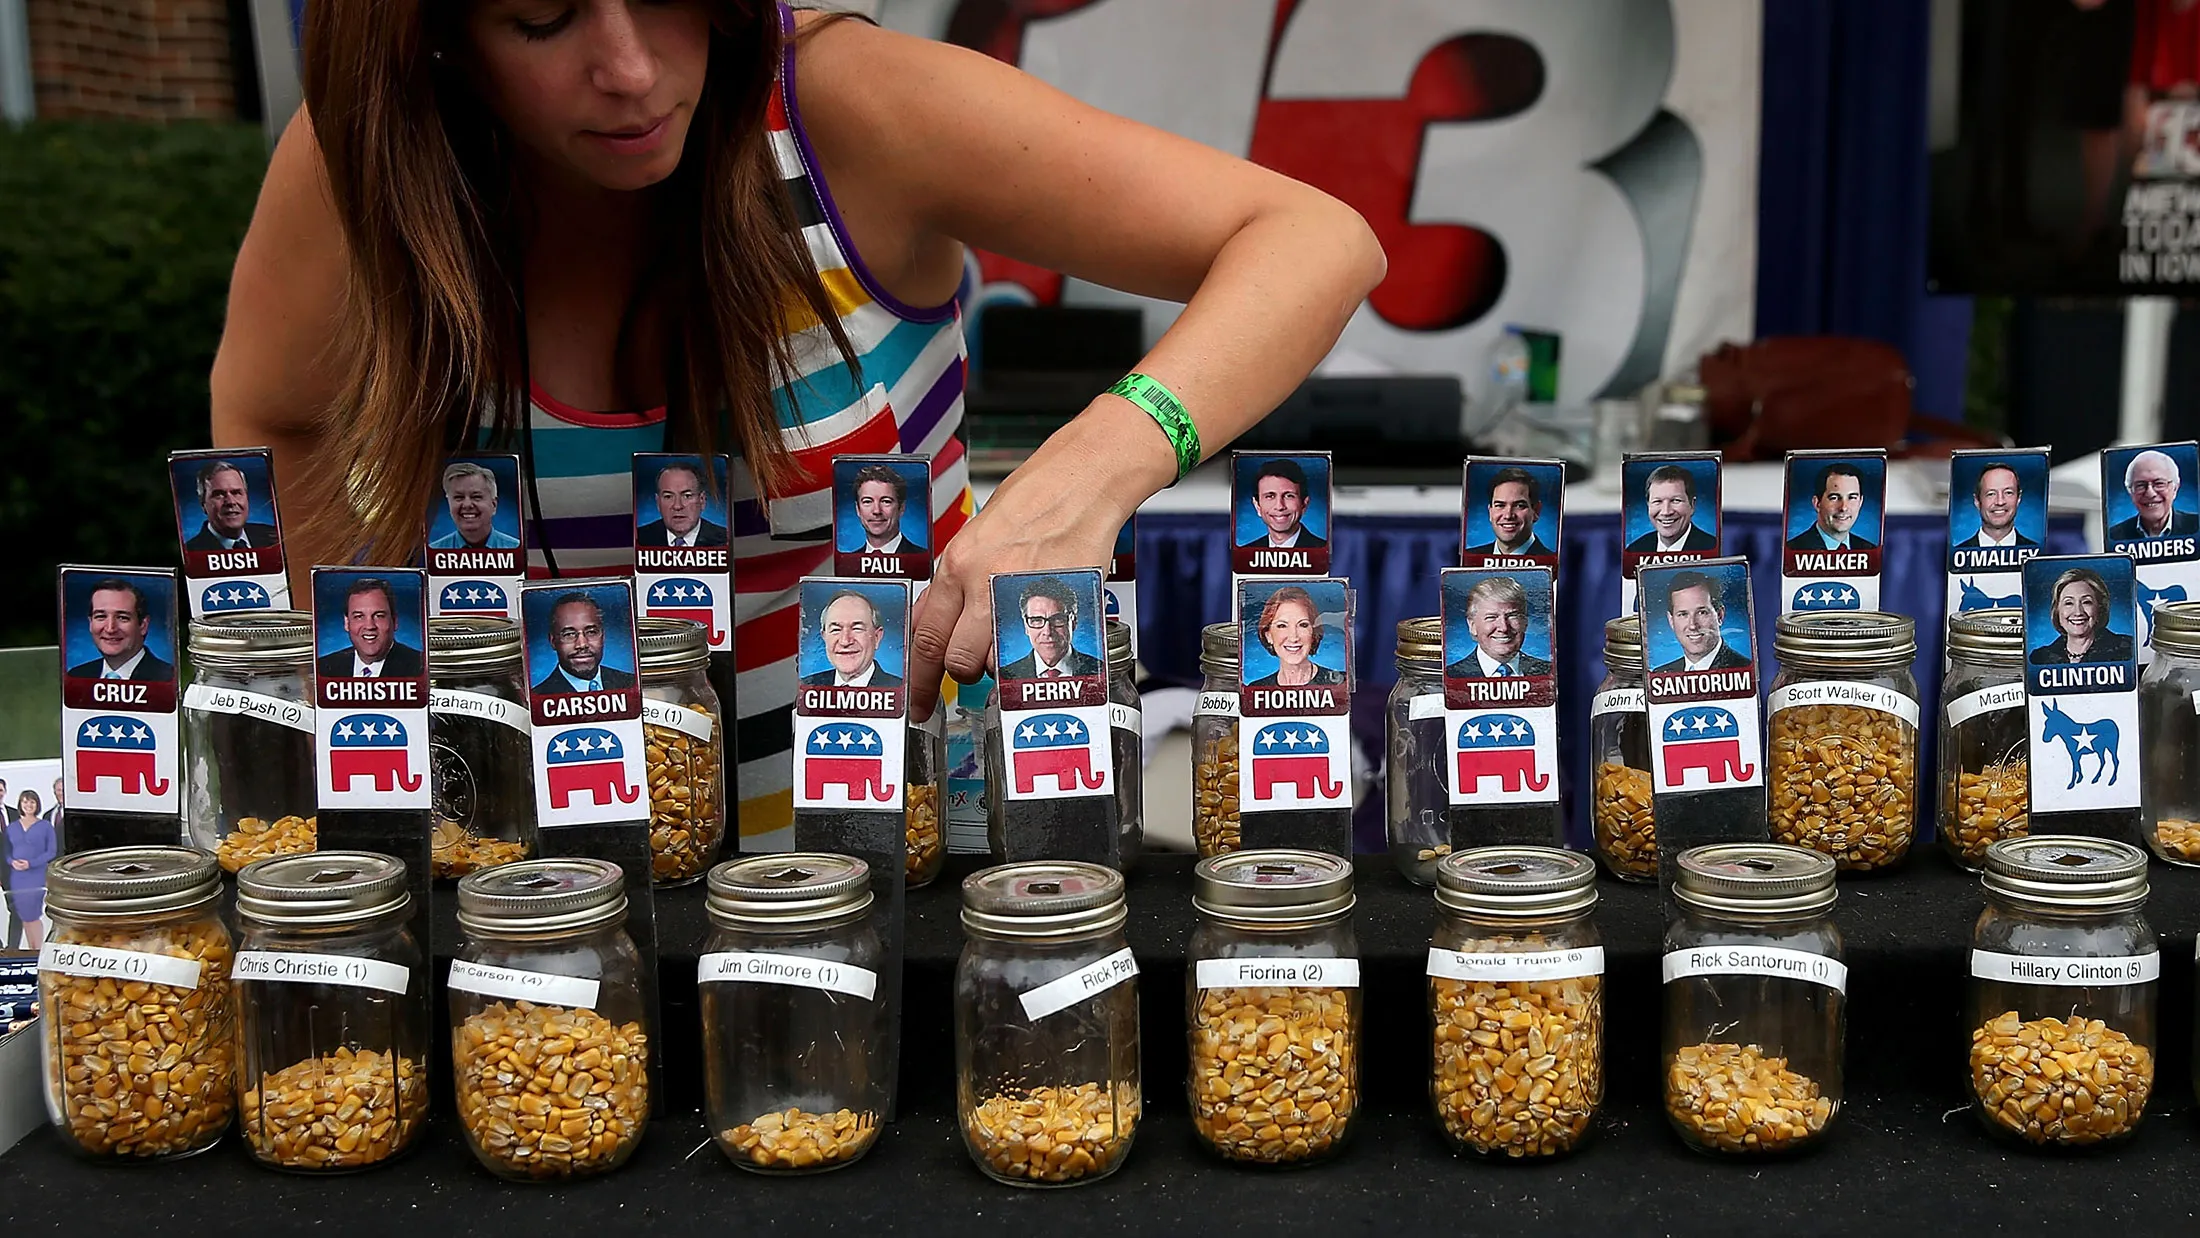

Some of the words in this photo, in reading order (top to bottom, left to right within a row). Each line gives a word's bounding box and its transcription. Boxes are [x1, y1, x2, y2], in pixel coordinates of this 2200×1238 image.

[2119, 252, 2152, 284] IN
[637, 549, 728, 567] HUCKABEE
[2114, 537, 2195, 560] SANDERS
[207, 552, 259, 571] BUSH
[434, 552, 515, 569] GRAHAM
[861, 557, 905, 574] PAUL
[1249, 551, 1312, 568] JINDAL
[1795, 553, 1869, 571] WALKER
[1651, 671, 1751, 697] SANTORUM
[2038, 665, 2125, 688] CLINTON
[93, 683, 148, 704] CRUZ
[325, 680, 418, 701] CHRISTIE
[805, 689, 895, 711] GILMORE
[1022, 680, 1083, 702] PERRY
[1254, 689, 1335, 710] FIORINA
[1466, 680, 1531, 701] TRUMP
[1604, 693, 1631, 708] John
[1788, 688, 1822, 701] Scott
[1826, 686, 1877, 703] Walker
[1881, 692, 1898, 709] (1)
[1978, 688, 2024, 707] Martin
[210, 693, 235, 708] Jeb
[239, 696, 277, 716] Bush
[282, 705, 302, 723] (2)
[428, 693, 483, 712] Graham
[488, 702, 506, 718] (1)
[542, 693, 627, 718] CARSON
[1201, 696, 1235, 712] Bobby
[664, 707, 683, 725] (1)
[1111, 707, 1127, 724] (1)
[52, 949, 75, 967] Ted
[79, 951, 117, 971] Cruz
[124, 956, 148, 976] (1)
[239, 956, 270, 974] Chris
[274, 958, 338, 977] Christie
[345, 962, 367, 981] (1)
[1456, 955, 1506, 966] Donald
[1513, 955, 1562, 966] Trump
[1567, 952, 1582, 963] (6)
[1690, 952, 1723, 969] Rick
[1728, 951, 1807, 973] Santorum
[1812, 959, 1829, 979] (1)
[467, 966, 515, 982] Carson
[521, 973, 543, 986] (4)
[718, 958, 742, 974] Jim
[747, 958, 812, 979] Gilmore
[818, 966, 839, 985] (1)
[1081, 966, 1113, 990] Rick
[1239, 964, 1297, 980] Fiorina
[1302, 964, 1323, 982] (2)
[2010, 961, 2061, 980] Hillary
[2066, 963, 2122, 979] Clinton
[2126, 961, 2142, 980] (5)
